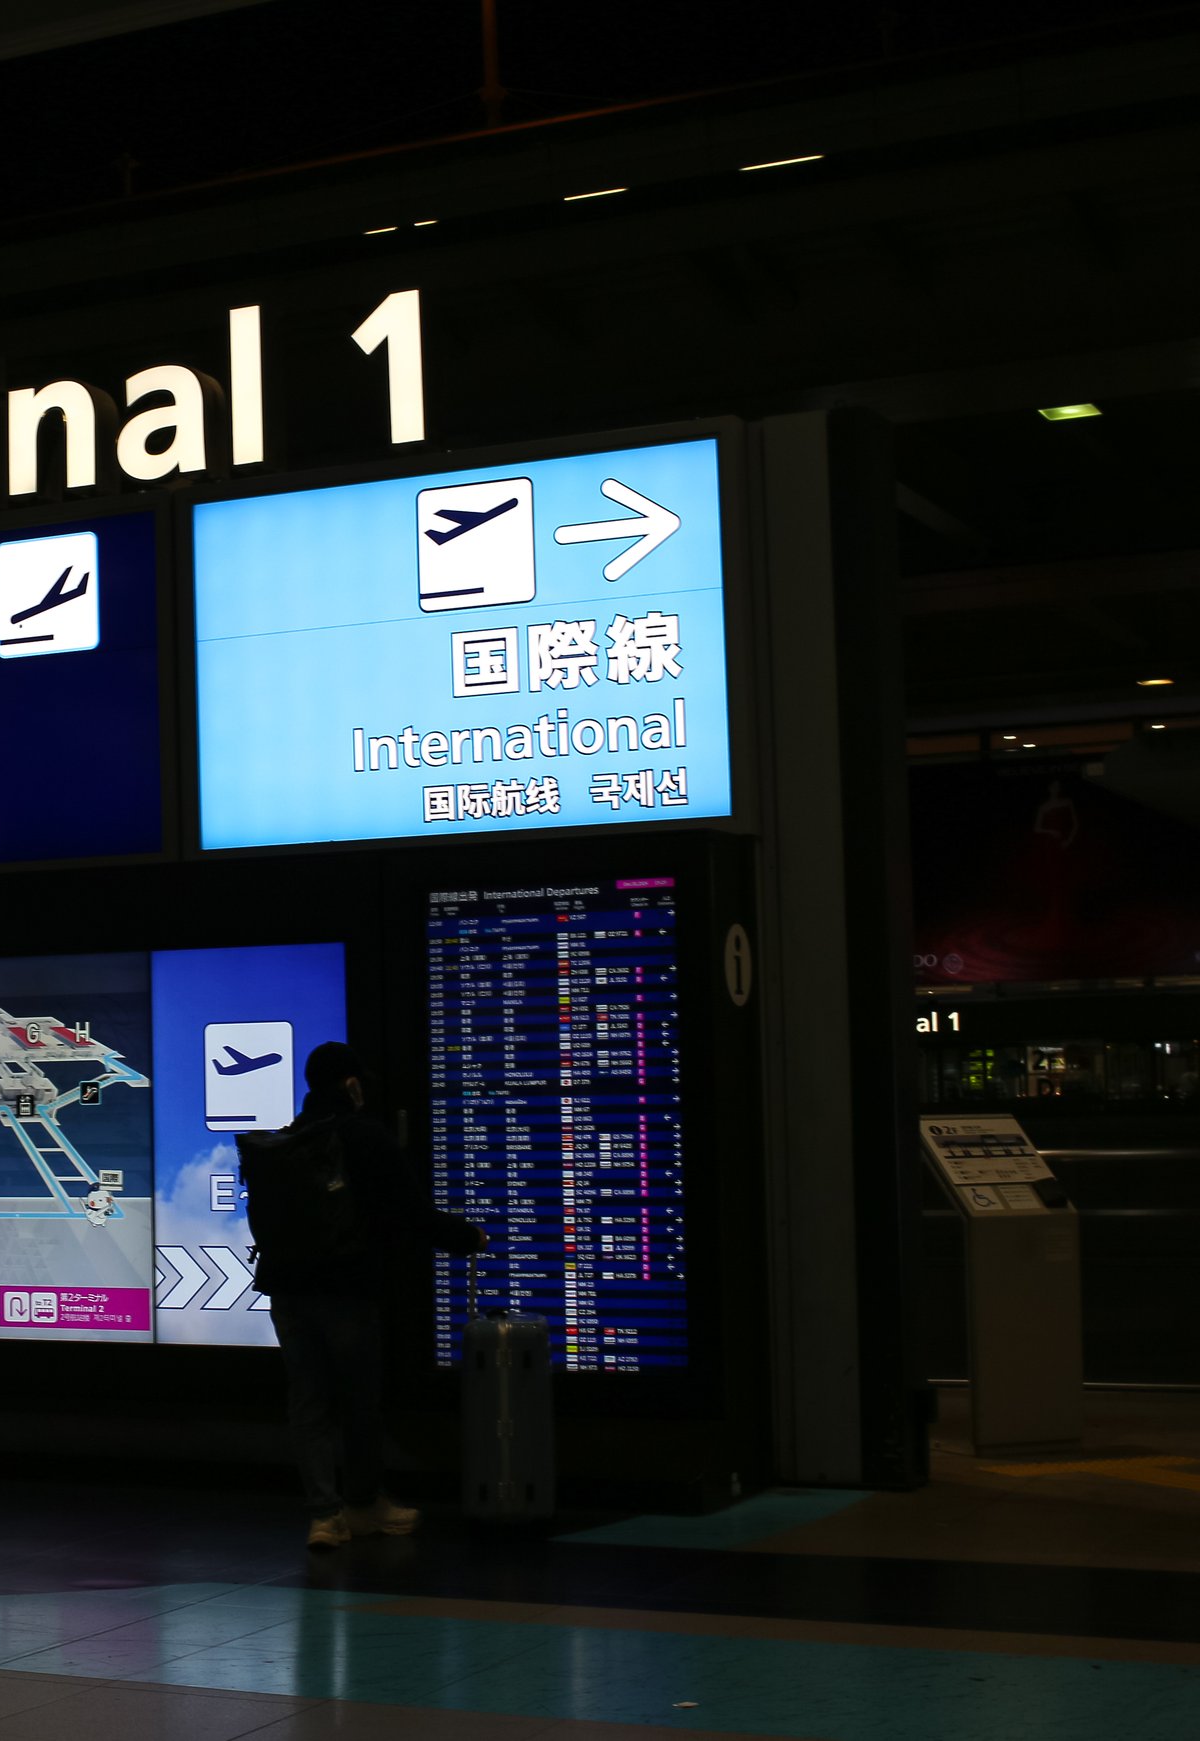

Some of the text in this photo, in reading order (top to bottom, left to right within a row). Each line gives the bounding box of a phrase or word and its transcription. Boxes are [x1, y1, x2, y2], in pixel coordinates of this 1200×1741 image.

[350, 290, 424, 444] 1
[451, 611, 684, 698] 国際線
[353, 697, 687, 772] International
[423, 767, 688, 822] 国际航线 국제선
[483, 887, 544, 900] International
[546, 886, 599, 898] Departures
[948, 1011, 960, 1032] 1
[26, 1023, 41, 1044] G
[75, 1022, 90, 1043] H
[60, 1304, 104, 1313] Terminal 2
